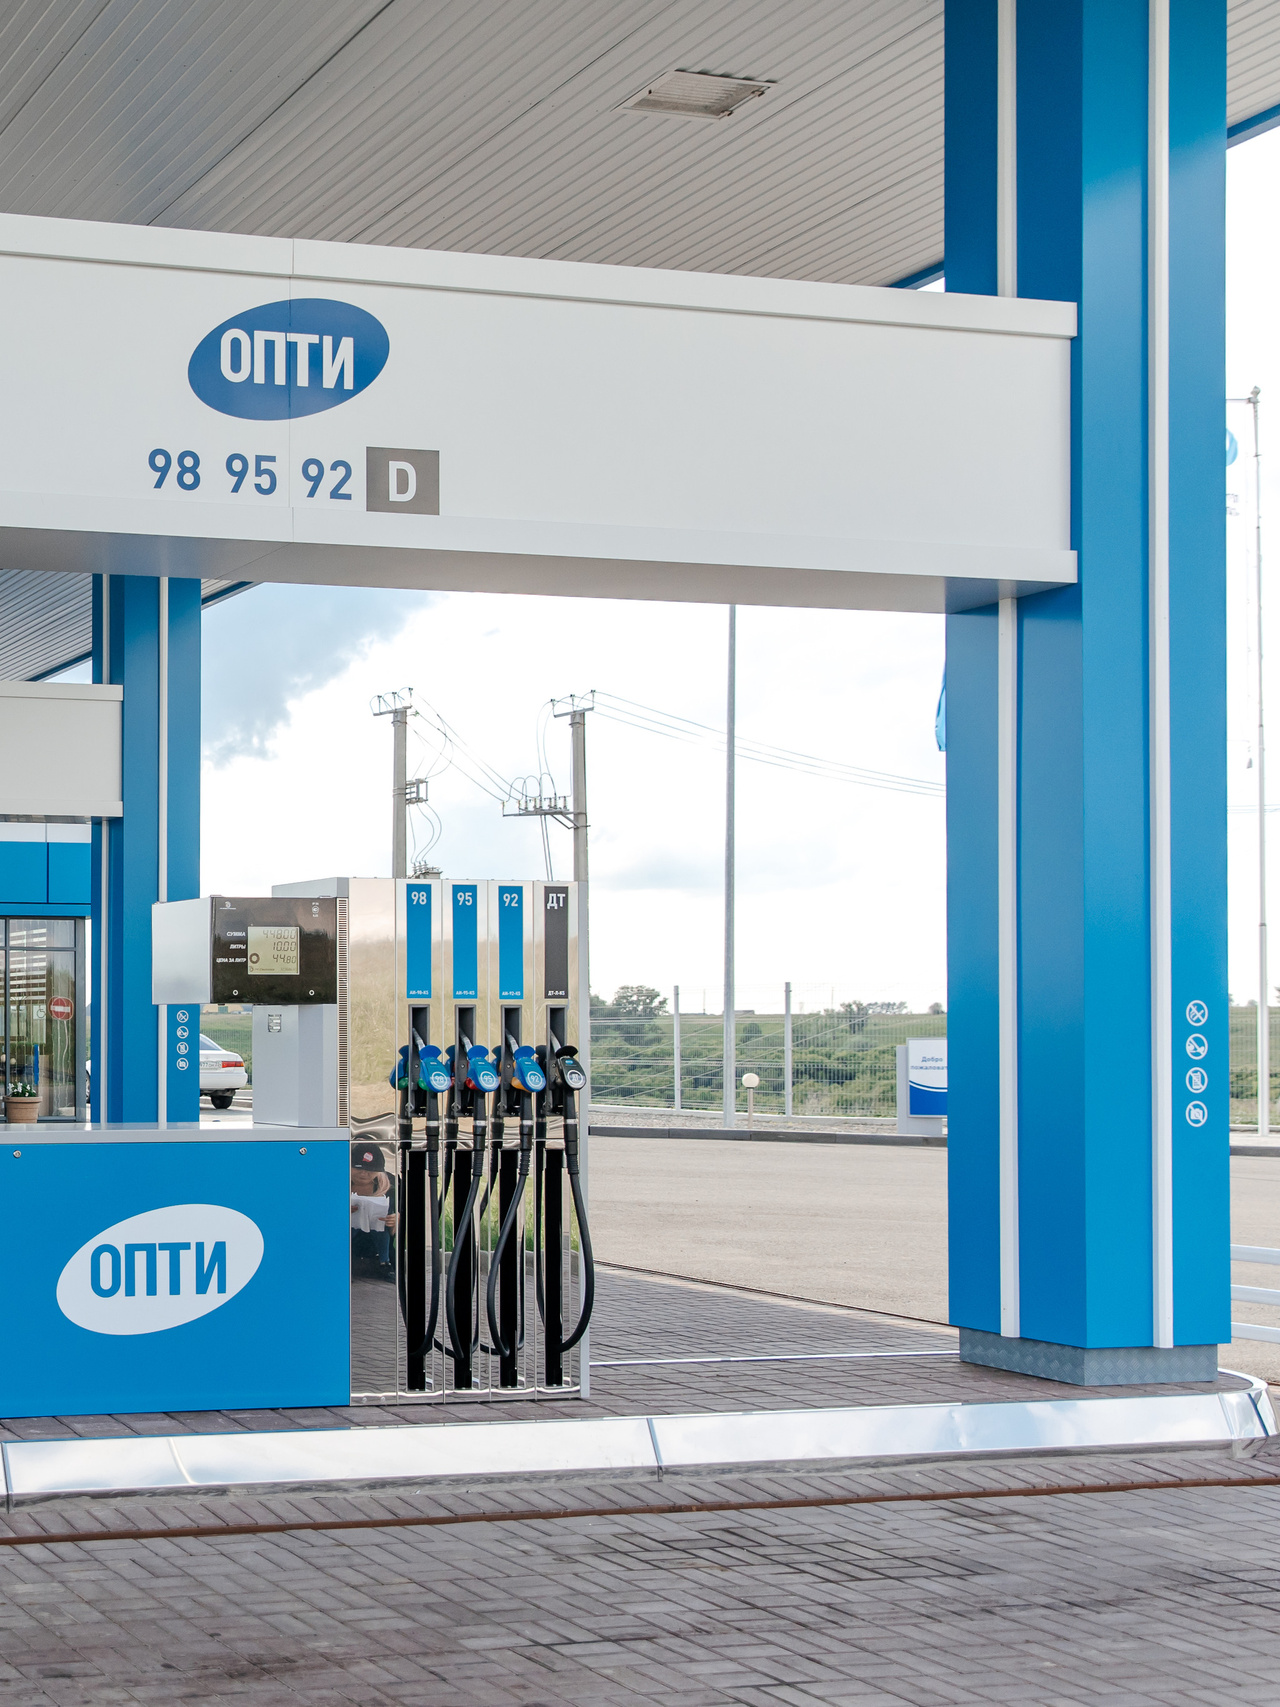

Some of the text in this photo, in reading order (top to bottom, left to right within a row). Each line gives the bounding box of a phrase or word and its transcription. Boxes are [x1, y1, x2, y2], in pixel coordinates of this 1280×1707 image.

[220, 328, 354, 390] ОПТИ
[148, 448, 418, 503] 98 95 92 D
[411, 891, 427, 905] 98
[457, 892, 473, 906] 95
[502, 893, 519, 907] 92
[546, 893, 566, 910] ДТ
[483, 1075, 492, 1083] 95
[530, 1075, 540, 1083] 92
[90, 1240, 227, 1298] ОПТИ
